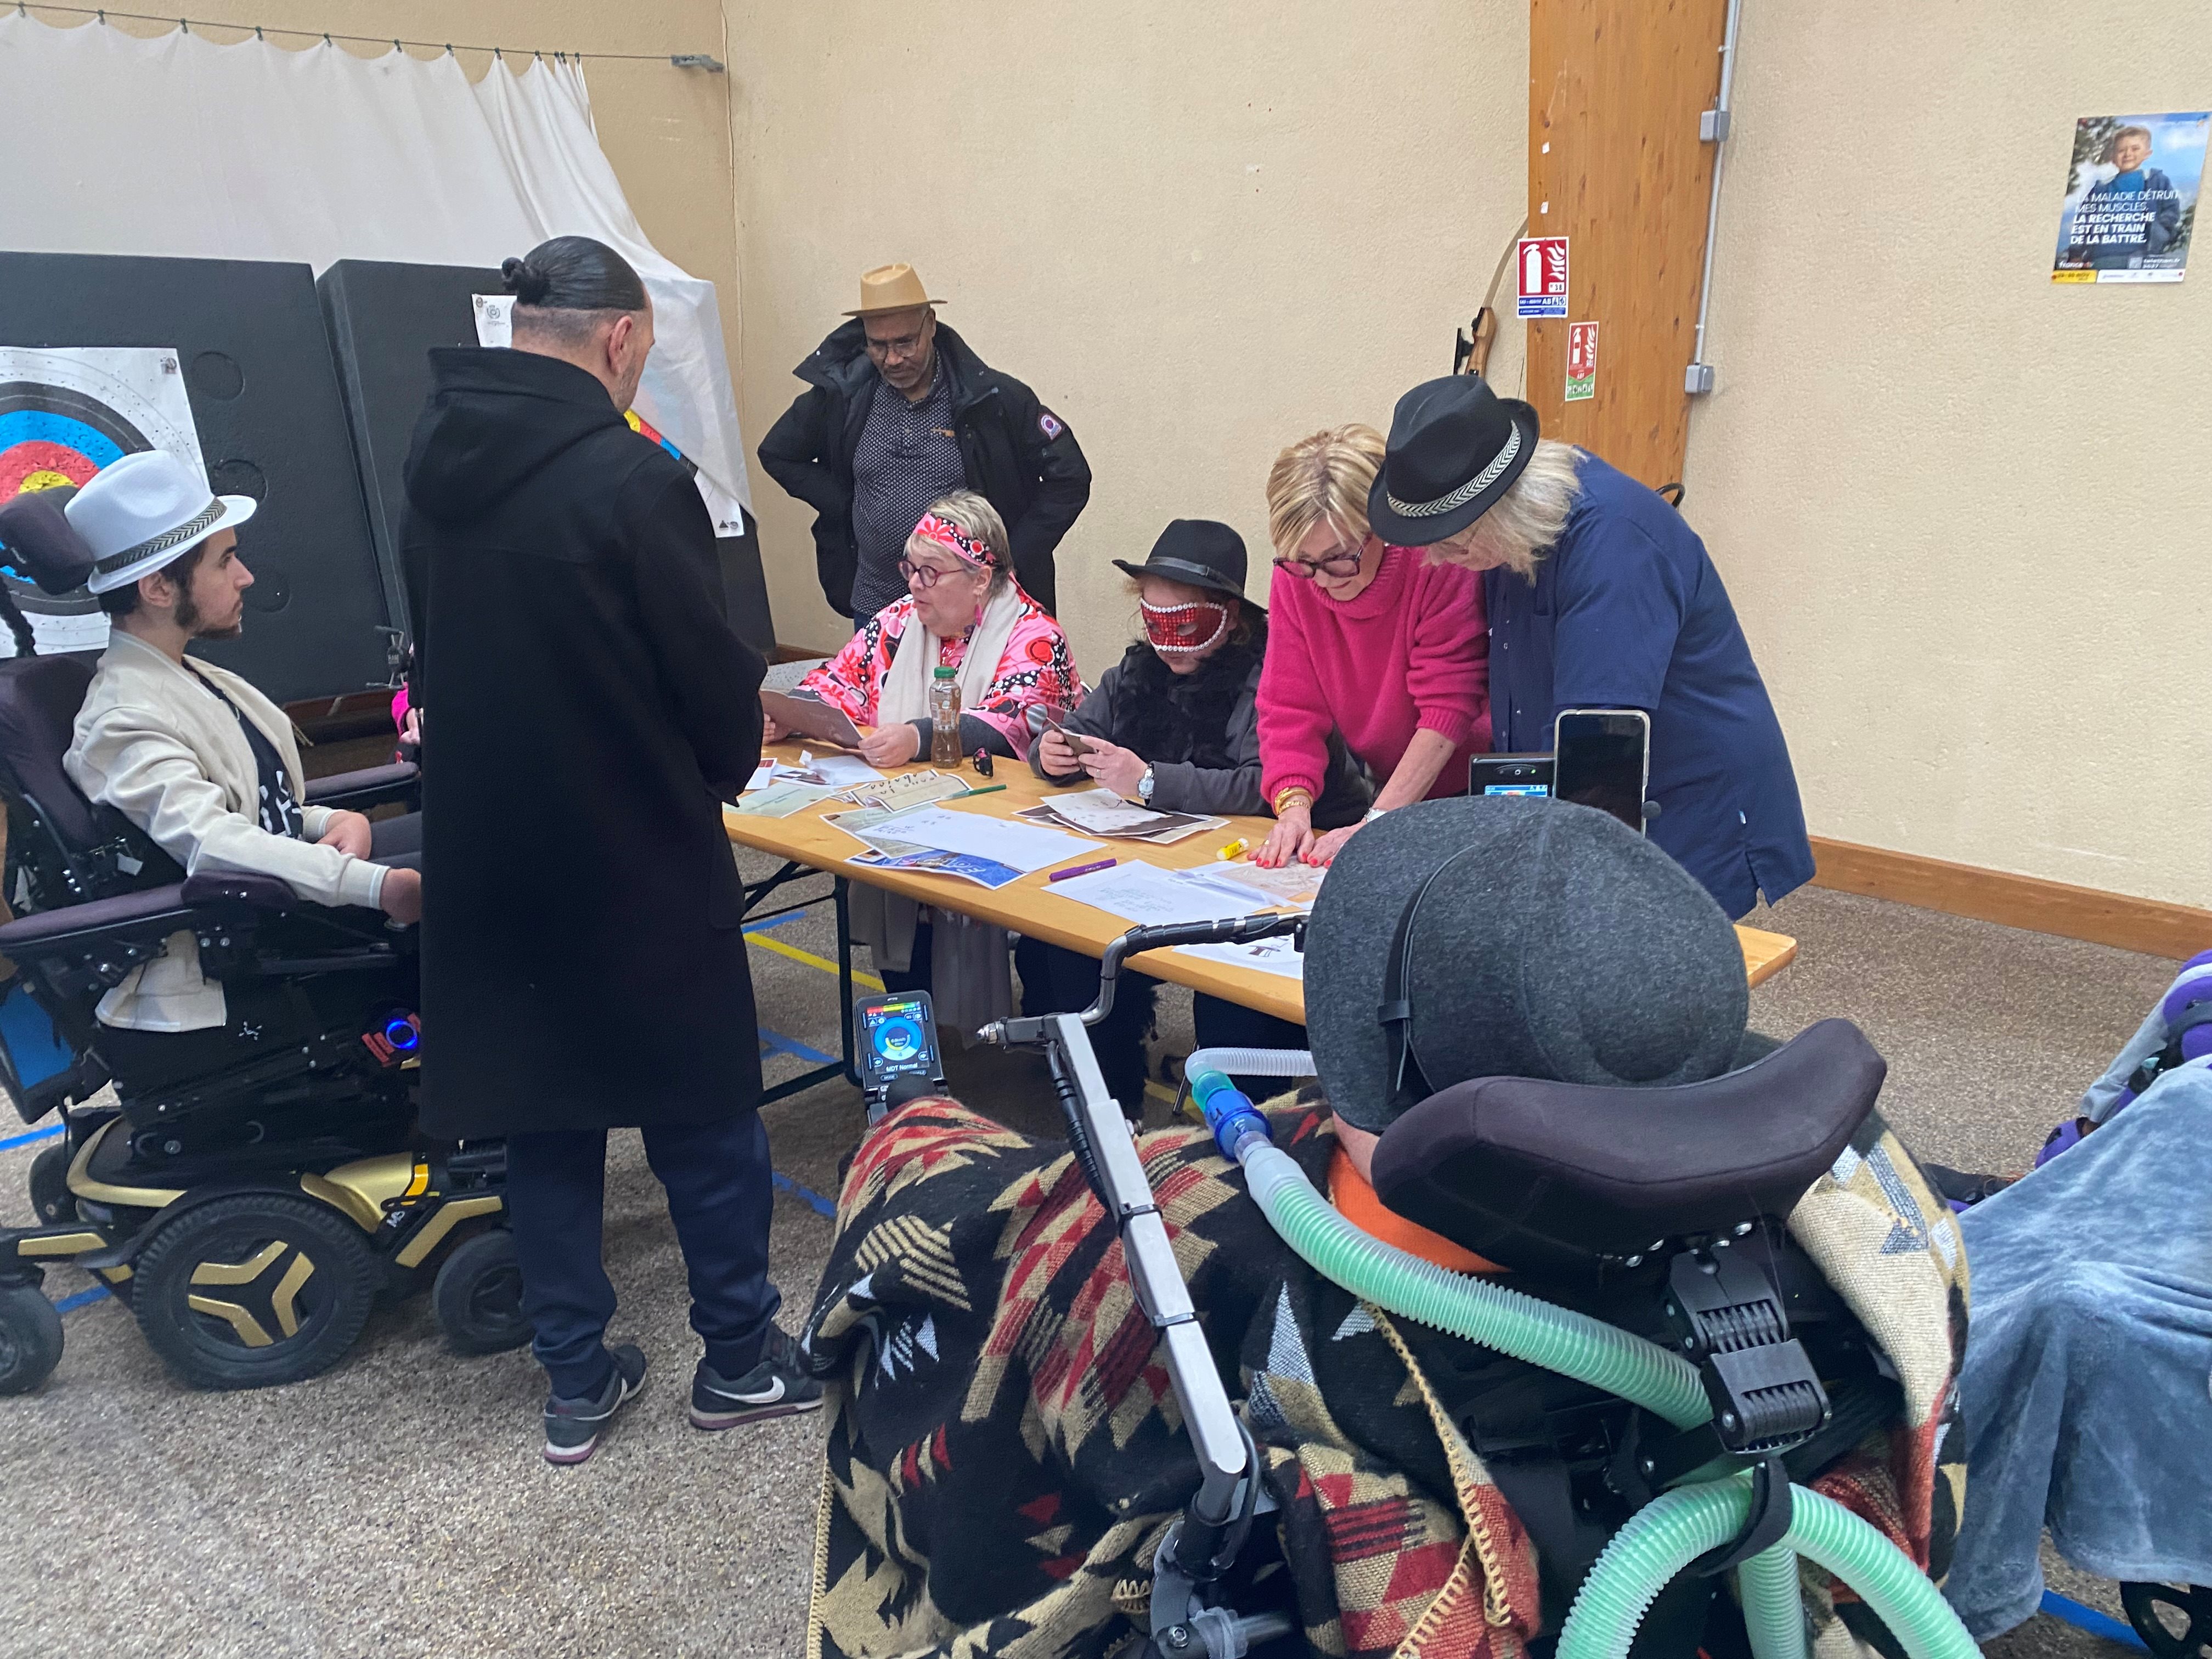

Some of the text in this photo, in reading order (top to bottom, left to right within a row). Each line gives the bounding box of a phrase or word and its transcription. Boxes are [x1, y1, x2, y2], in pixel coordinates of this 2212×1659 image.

[2091, 191, 2136, 202] MALADIE
[2075, 202, 2097, 213] MES
[2073, 212, 2155, 224] LA RECHERCHE
[2072, 223, 2145, 234] EST EN TRAIN
[2070, 235, 2084, 245] DE
[2086, 234, 2100, 244] LA
[899, 1062, 918, 1070] Normal
